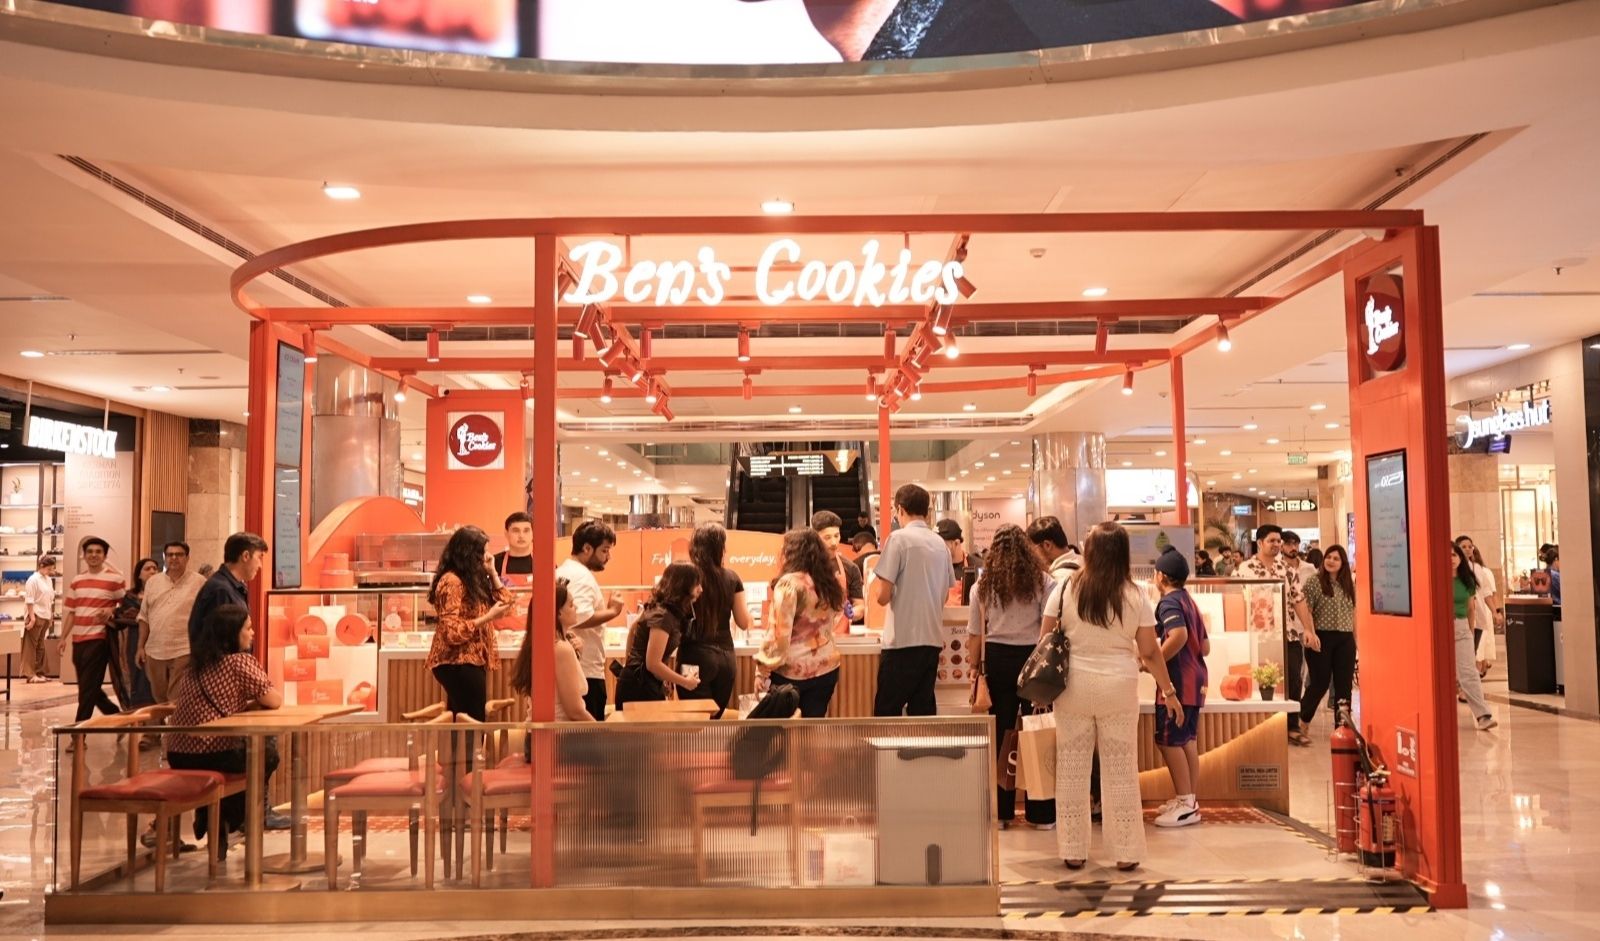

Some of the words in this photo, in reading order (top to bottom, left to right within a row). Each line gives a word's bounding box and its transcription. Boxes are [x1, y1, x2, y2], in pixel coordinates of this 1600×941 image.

[563, 240, 732, 307] Ben's
[755, 238, 965, 307] Cookies
[27, 415, 118, 459] BIRKENSTOCK
[972, 509, 1001, 523] dyson
